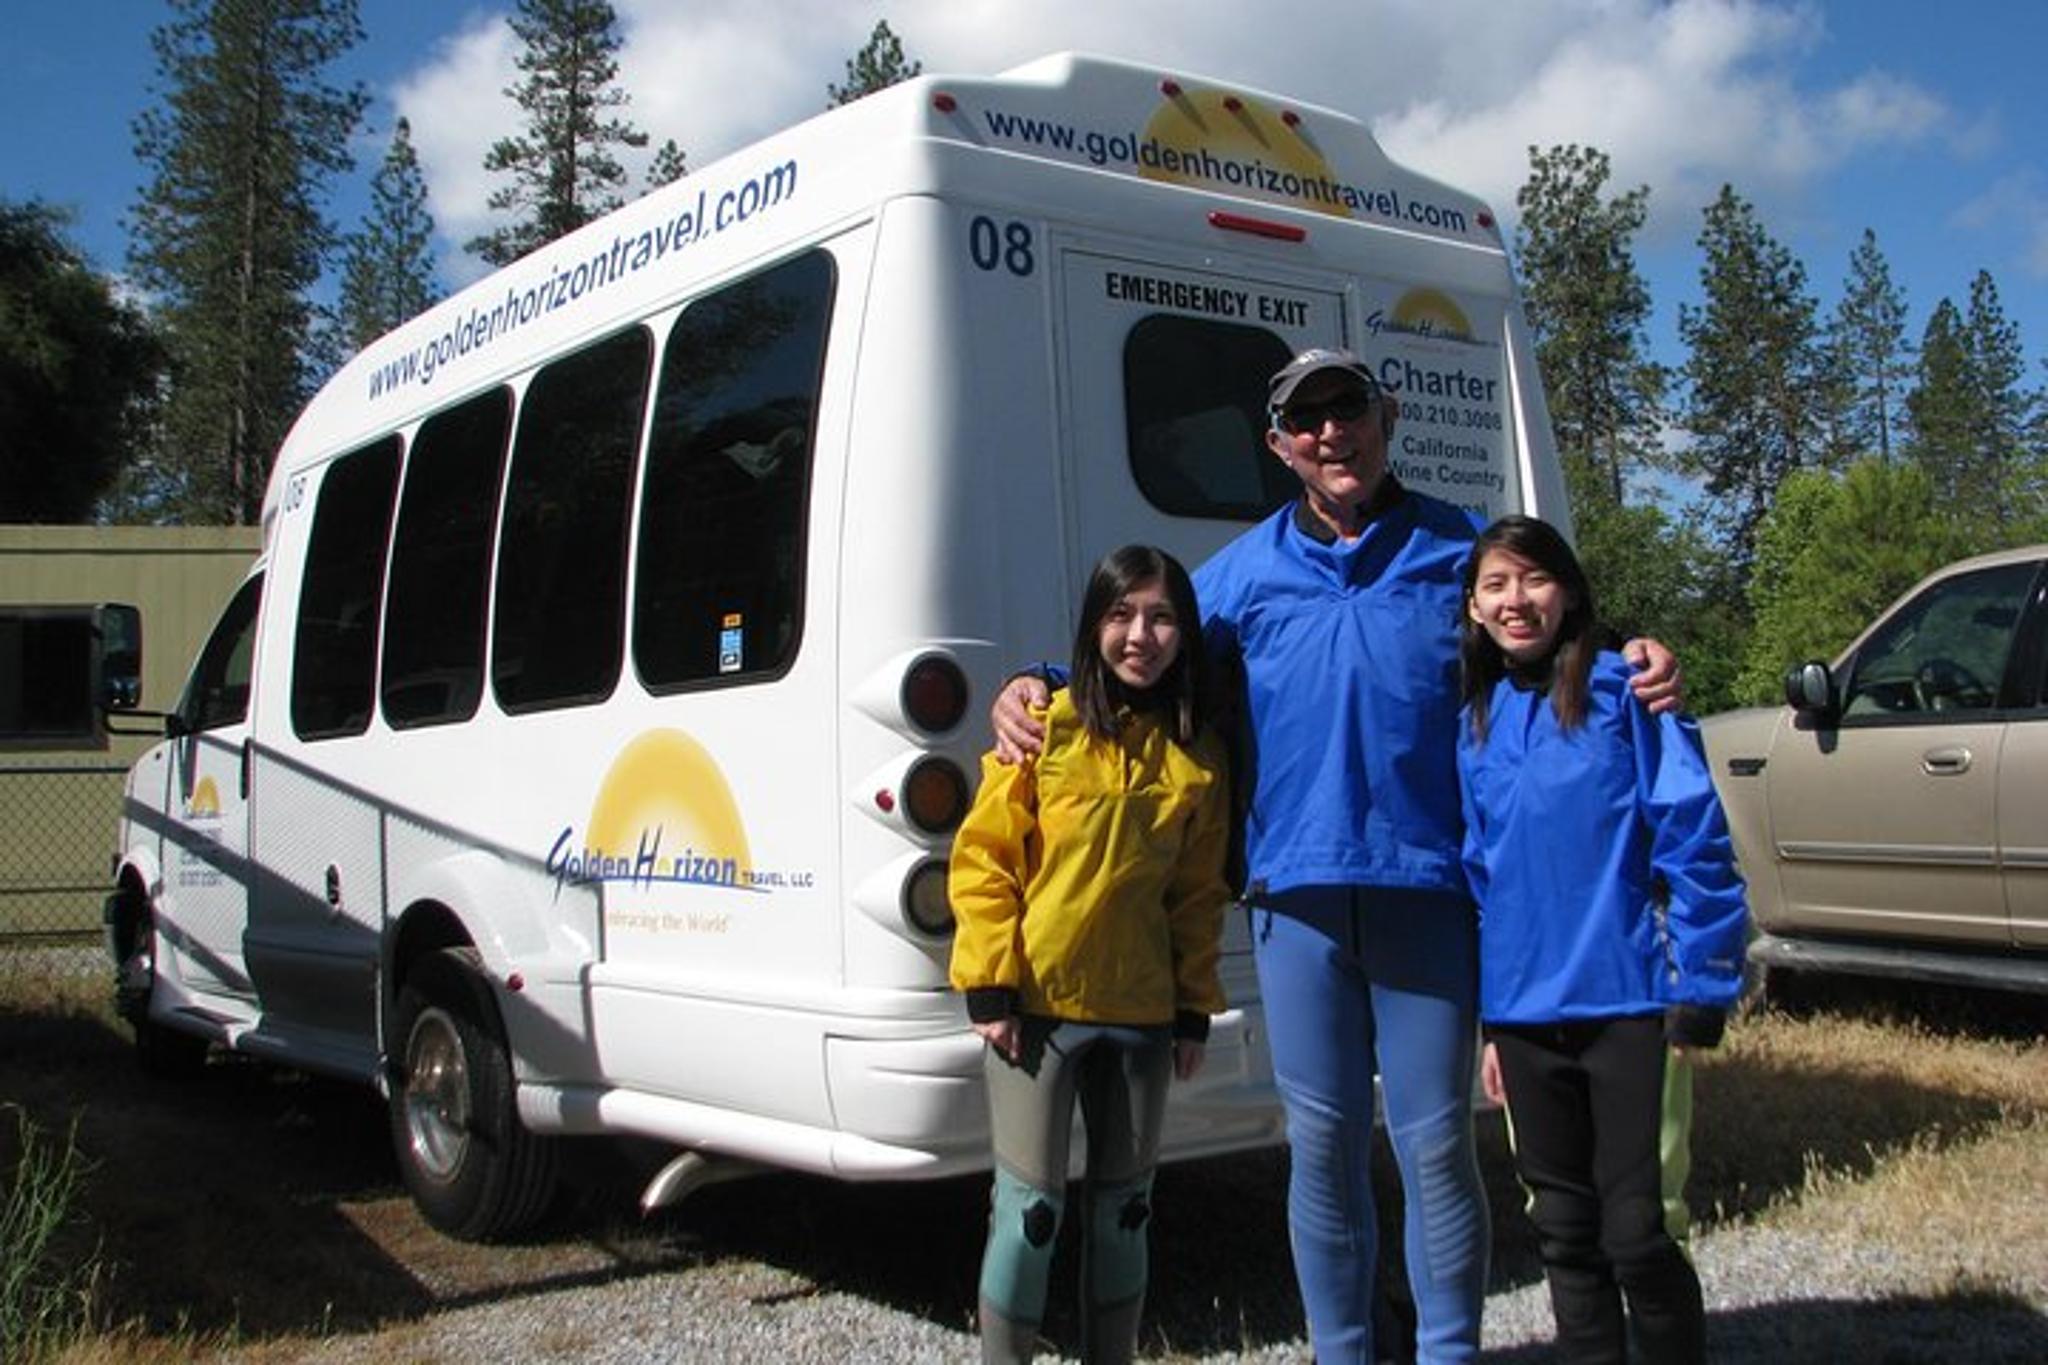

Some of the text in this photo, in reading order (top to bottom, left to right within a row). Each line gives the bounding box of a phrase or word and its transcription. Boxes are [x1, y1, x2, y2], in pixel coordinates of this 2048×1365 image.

[985, 109, 1467, 233] www.goldenhorizontravel.com
[970, 215, 1034, 276] 08
[368, 158, 798, 400] www.goldenhorizontravel.com
[1106, 272, 1309, 327] EMERGENCY EXIT
[1380, 358, 1496, 401] Charter
[1402, 435, 1488, 462] California
[1438, 464, 1505, 492] Country
[545, 826, 630, 904] Golden
[790, 872, 814, 888] LLC
